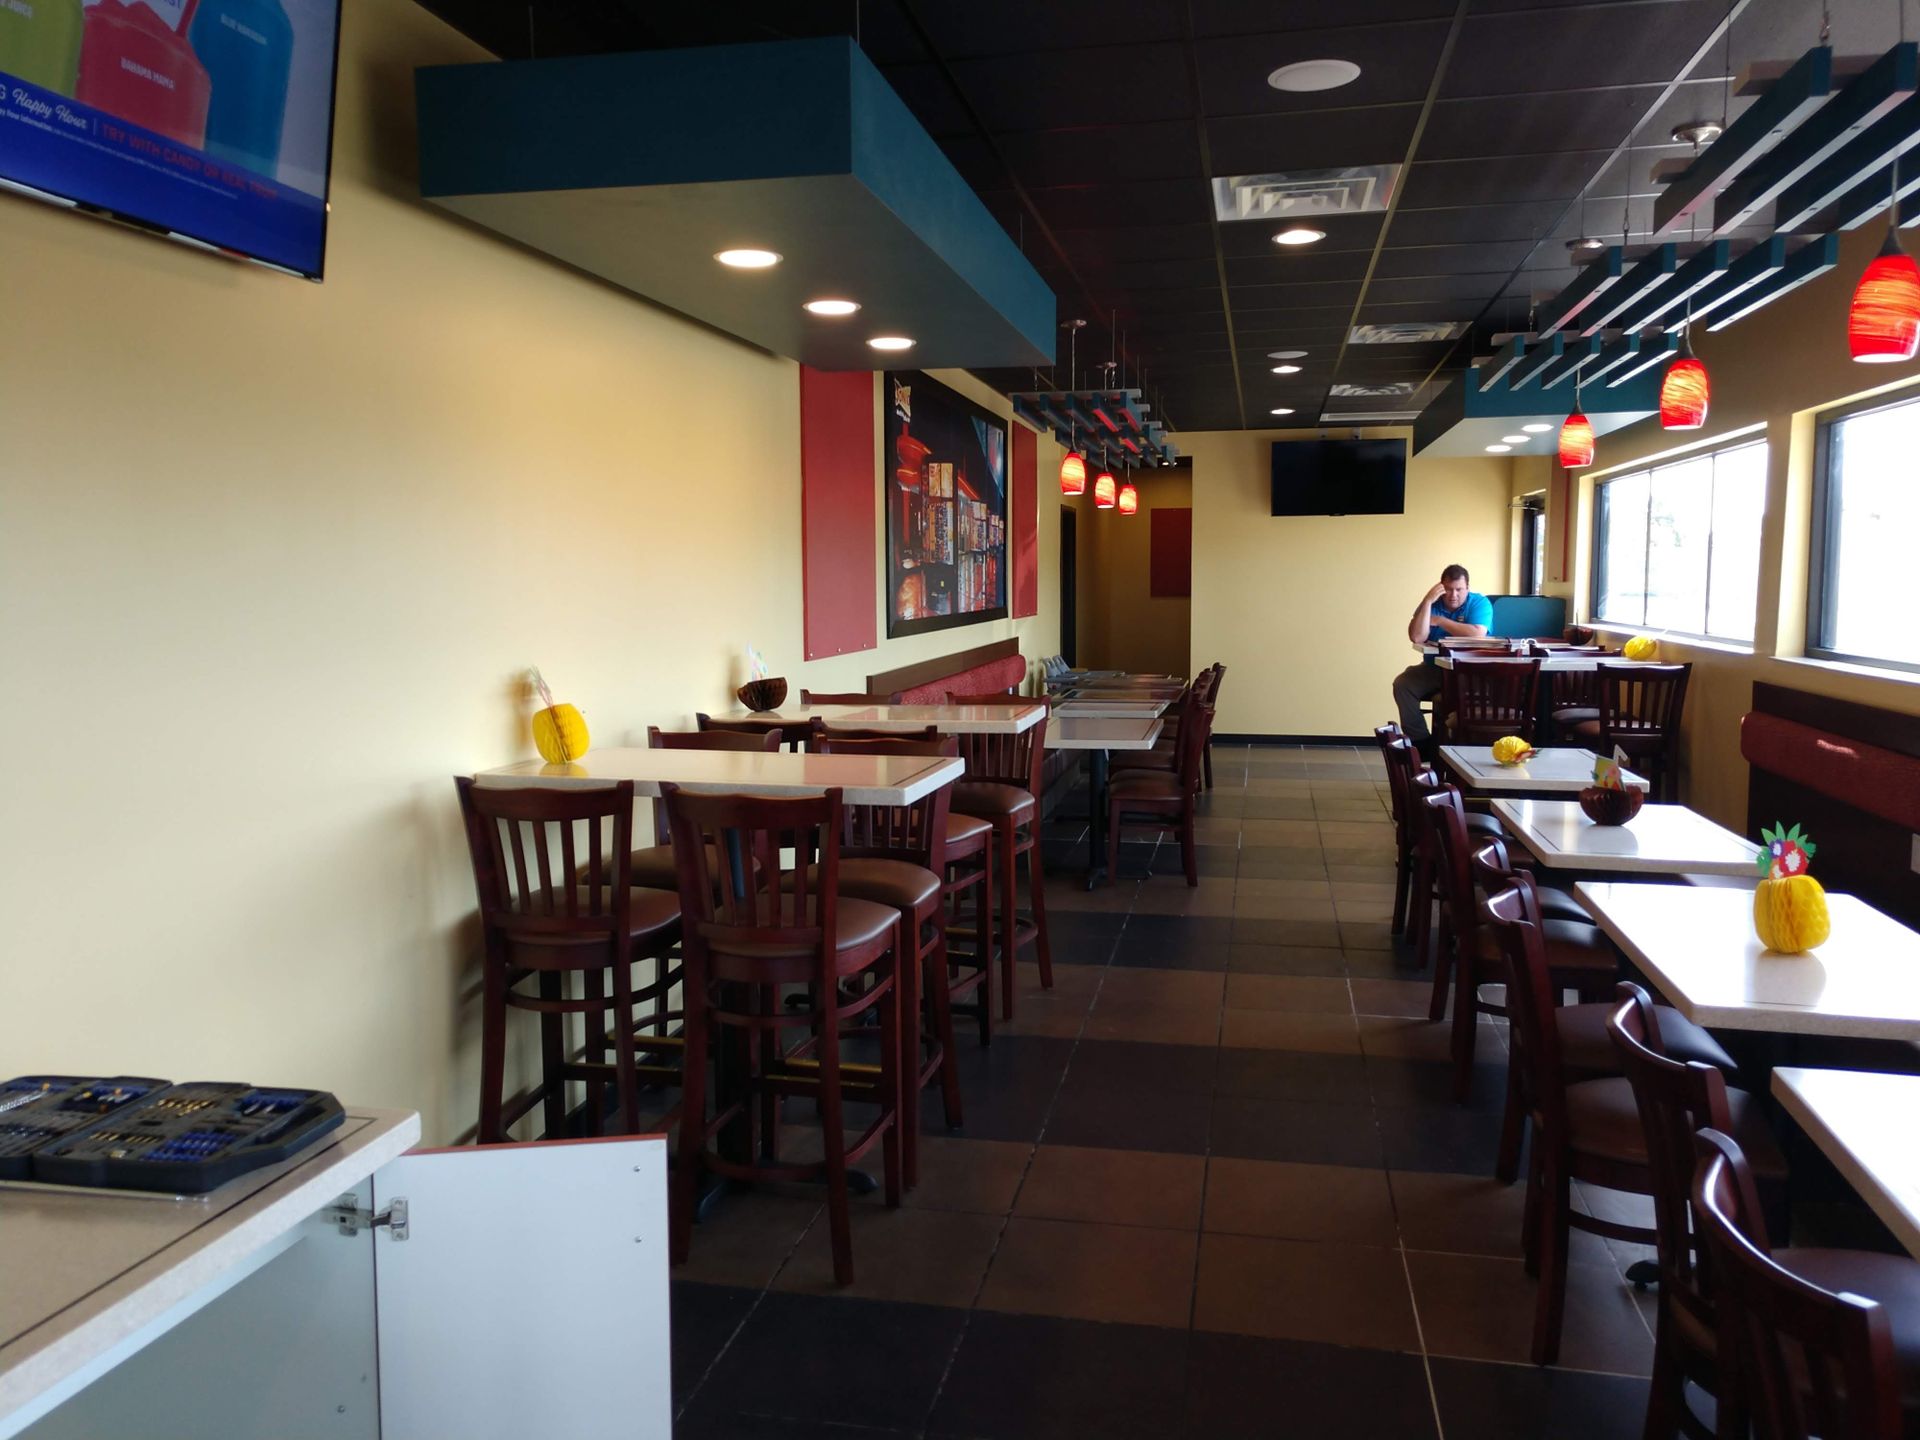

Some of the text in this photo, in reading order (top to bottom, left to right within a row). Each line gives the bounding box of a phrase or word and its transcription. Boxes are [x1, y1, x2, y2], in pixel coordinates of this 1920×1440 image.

[12, 87, 52, 119] Happy
[55, 104, 88, 130] Hour
[101, 123, 126, 144] TRY
[127, 133, 161, 157] WITH
[161, 146, 202, 172] CANDY
